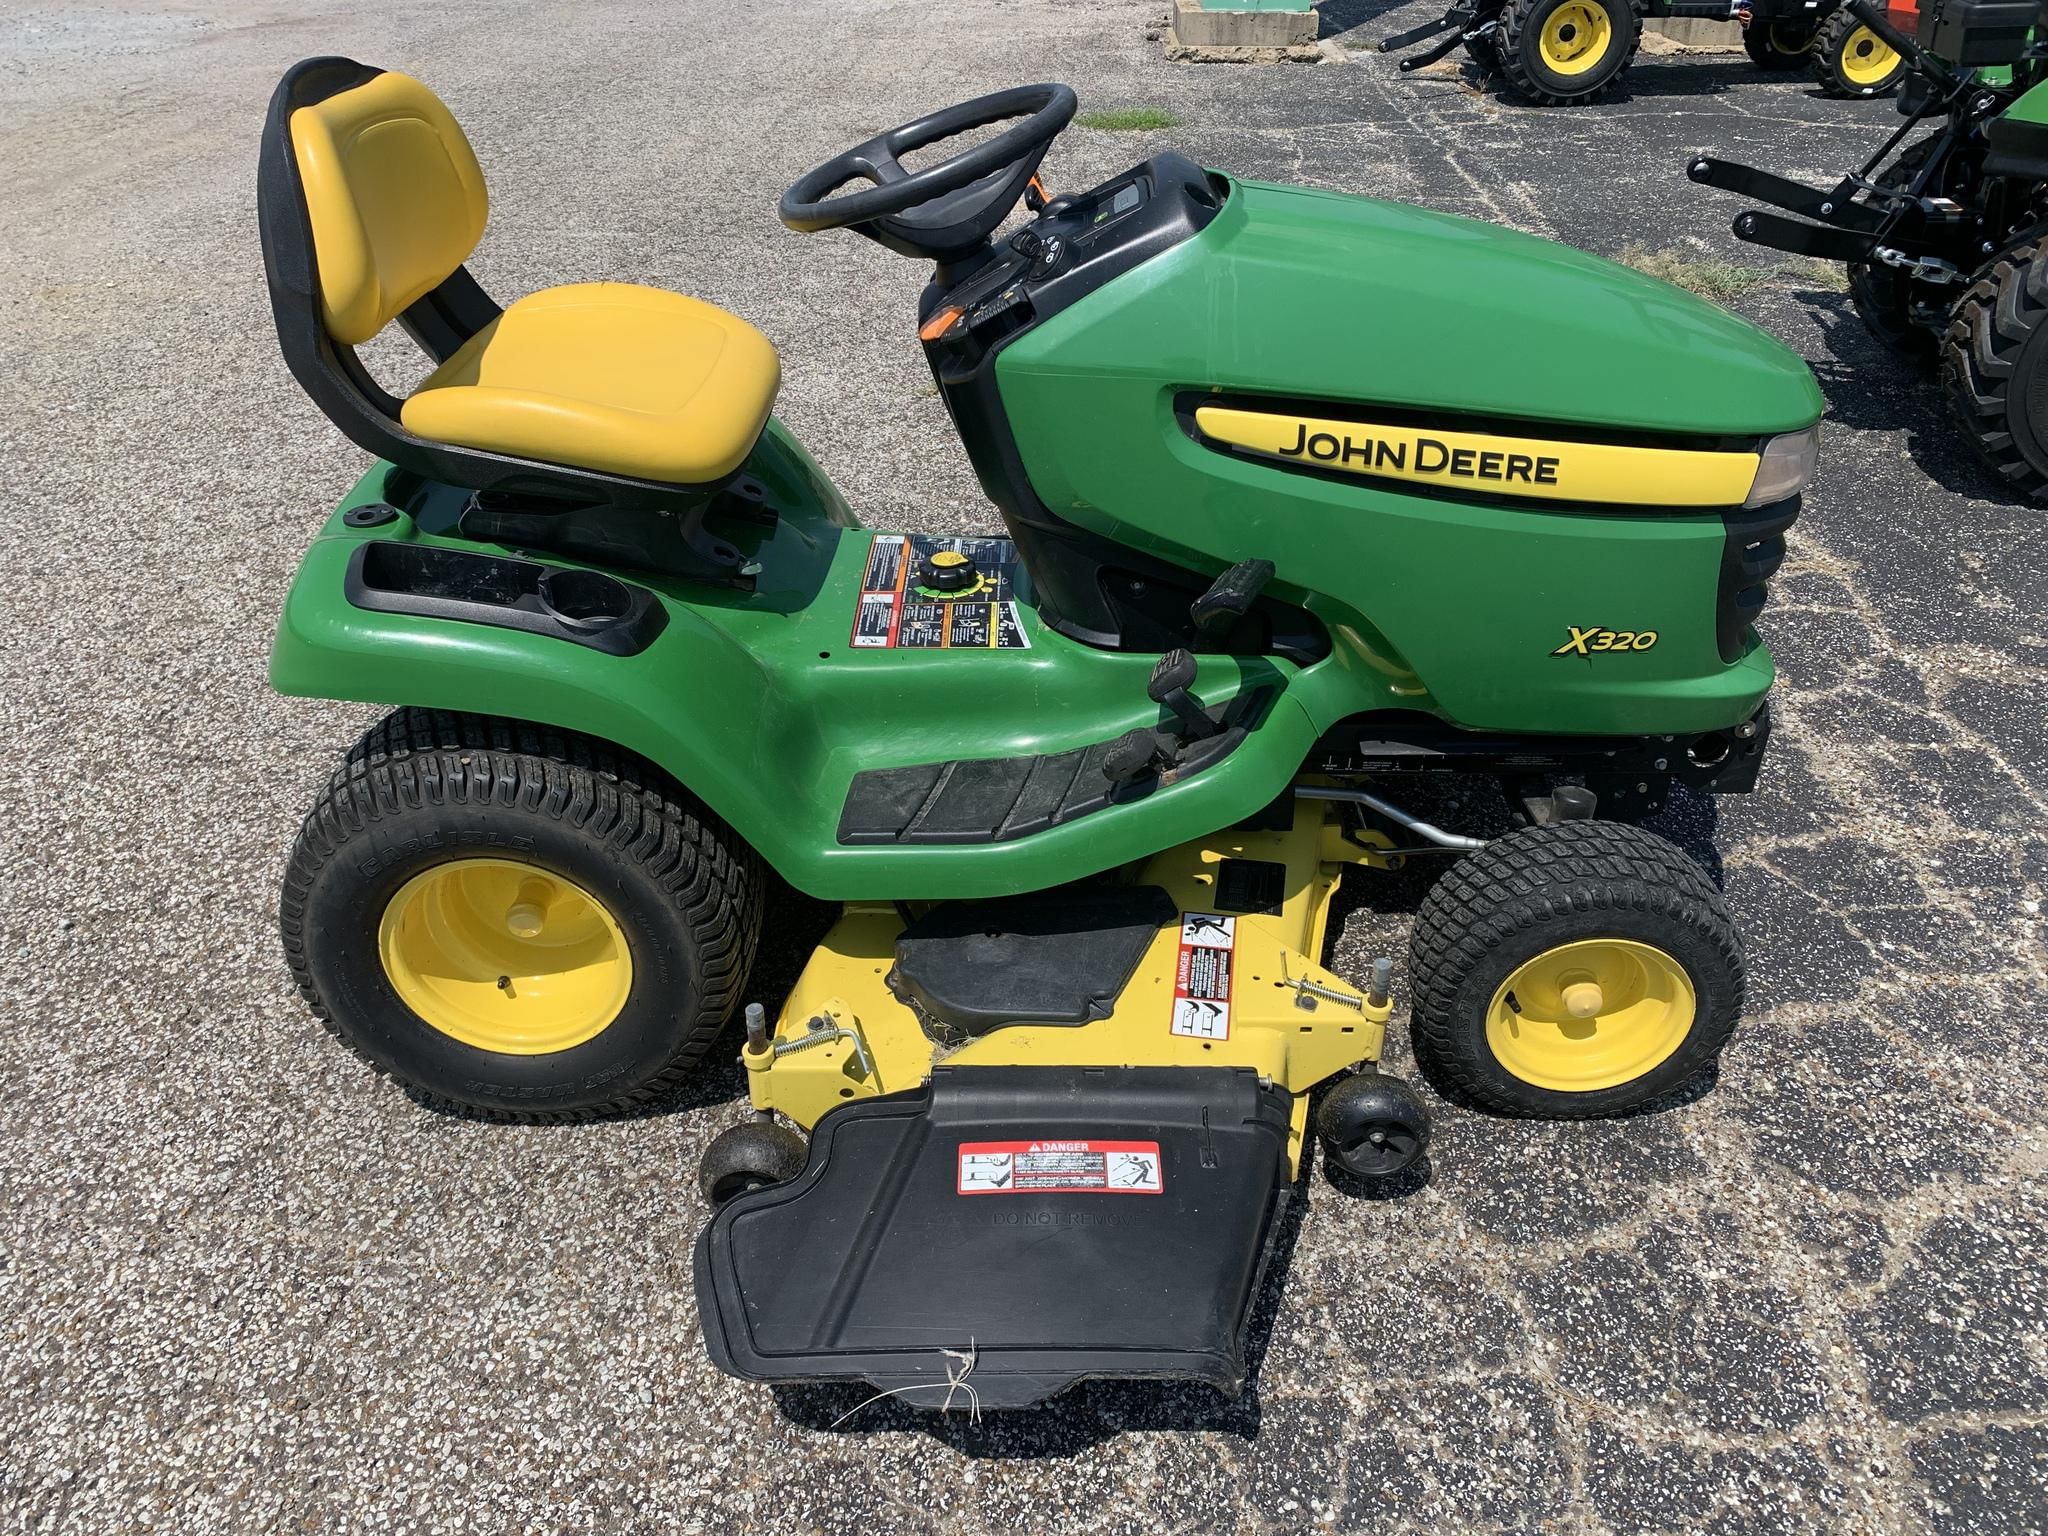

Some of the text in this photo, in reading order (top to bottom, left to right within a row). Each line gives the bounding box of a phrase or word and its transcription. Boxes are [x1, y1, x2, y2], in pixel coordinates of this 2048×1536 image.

[1279, 424, 1560, 484] JOHN DEERE
[1549, 626, 1658, 657] X320
[358, 831, 537, 878] CARLISLE
[1178, 951, 1190, 982] DANGER
[1042, 1143, 1089, 1152] DANGER
[993, 1212, 1145, 1226] DO NOT REMOVE
